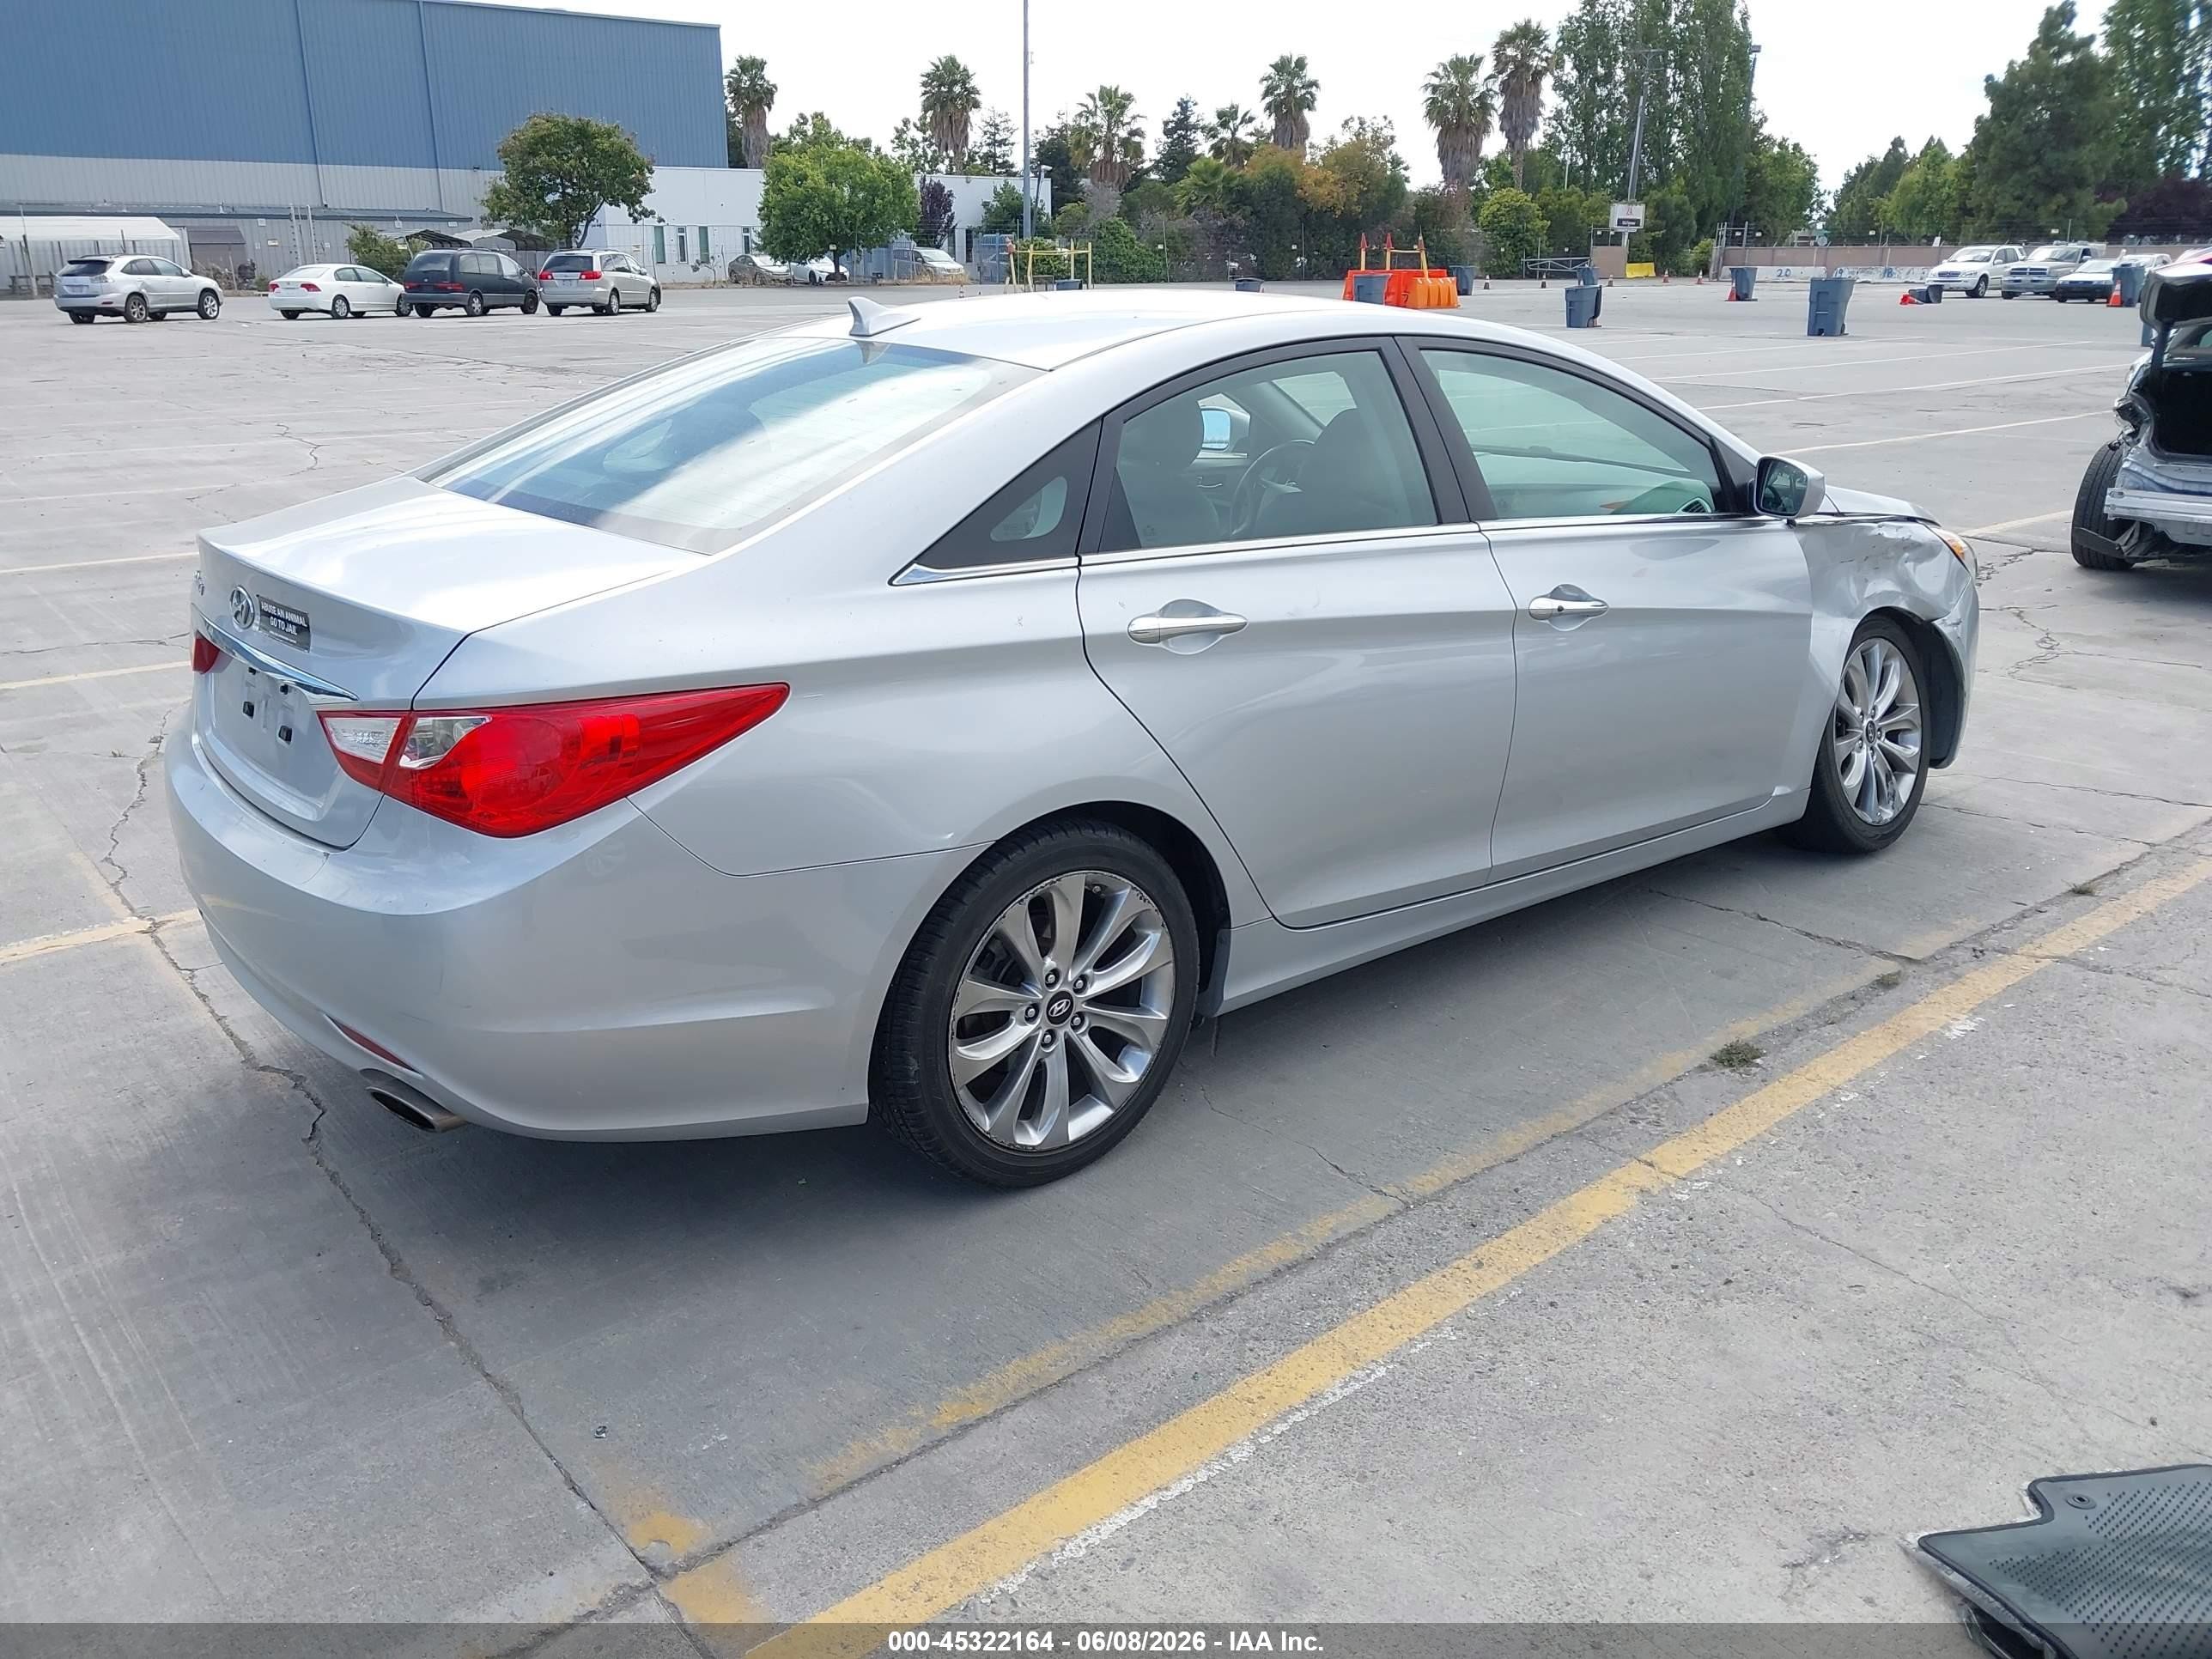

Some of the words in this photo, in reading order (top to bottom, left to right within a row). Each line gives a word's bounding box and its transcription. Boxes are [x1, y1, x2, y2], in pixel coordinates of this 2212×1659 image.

[1776, 268, 1792, 278] 20
[261, 600, 277, 616] ABUSE
[276, 607, 285, 618] AN
[285, 611, 307, 628] ANIMAL
[270, 616, 277, 628] GO
[277, 619, 286, 630] TO
[285, 623, 298, 635] JAIL
